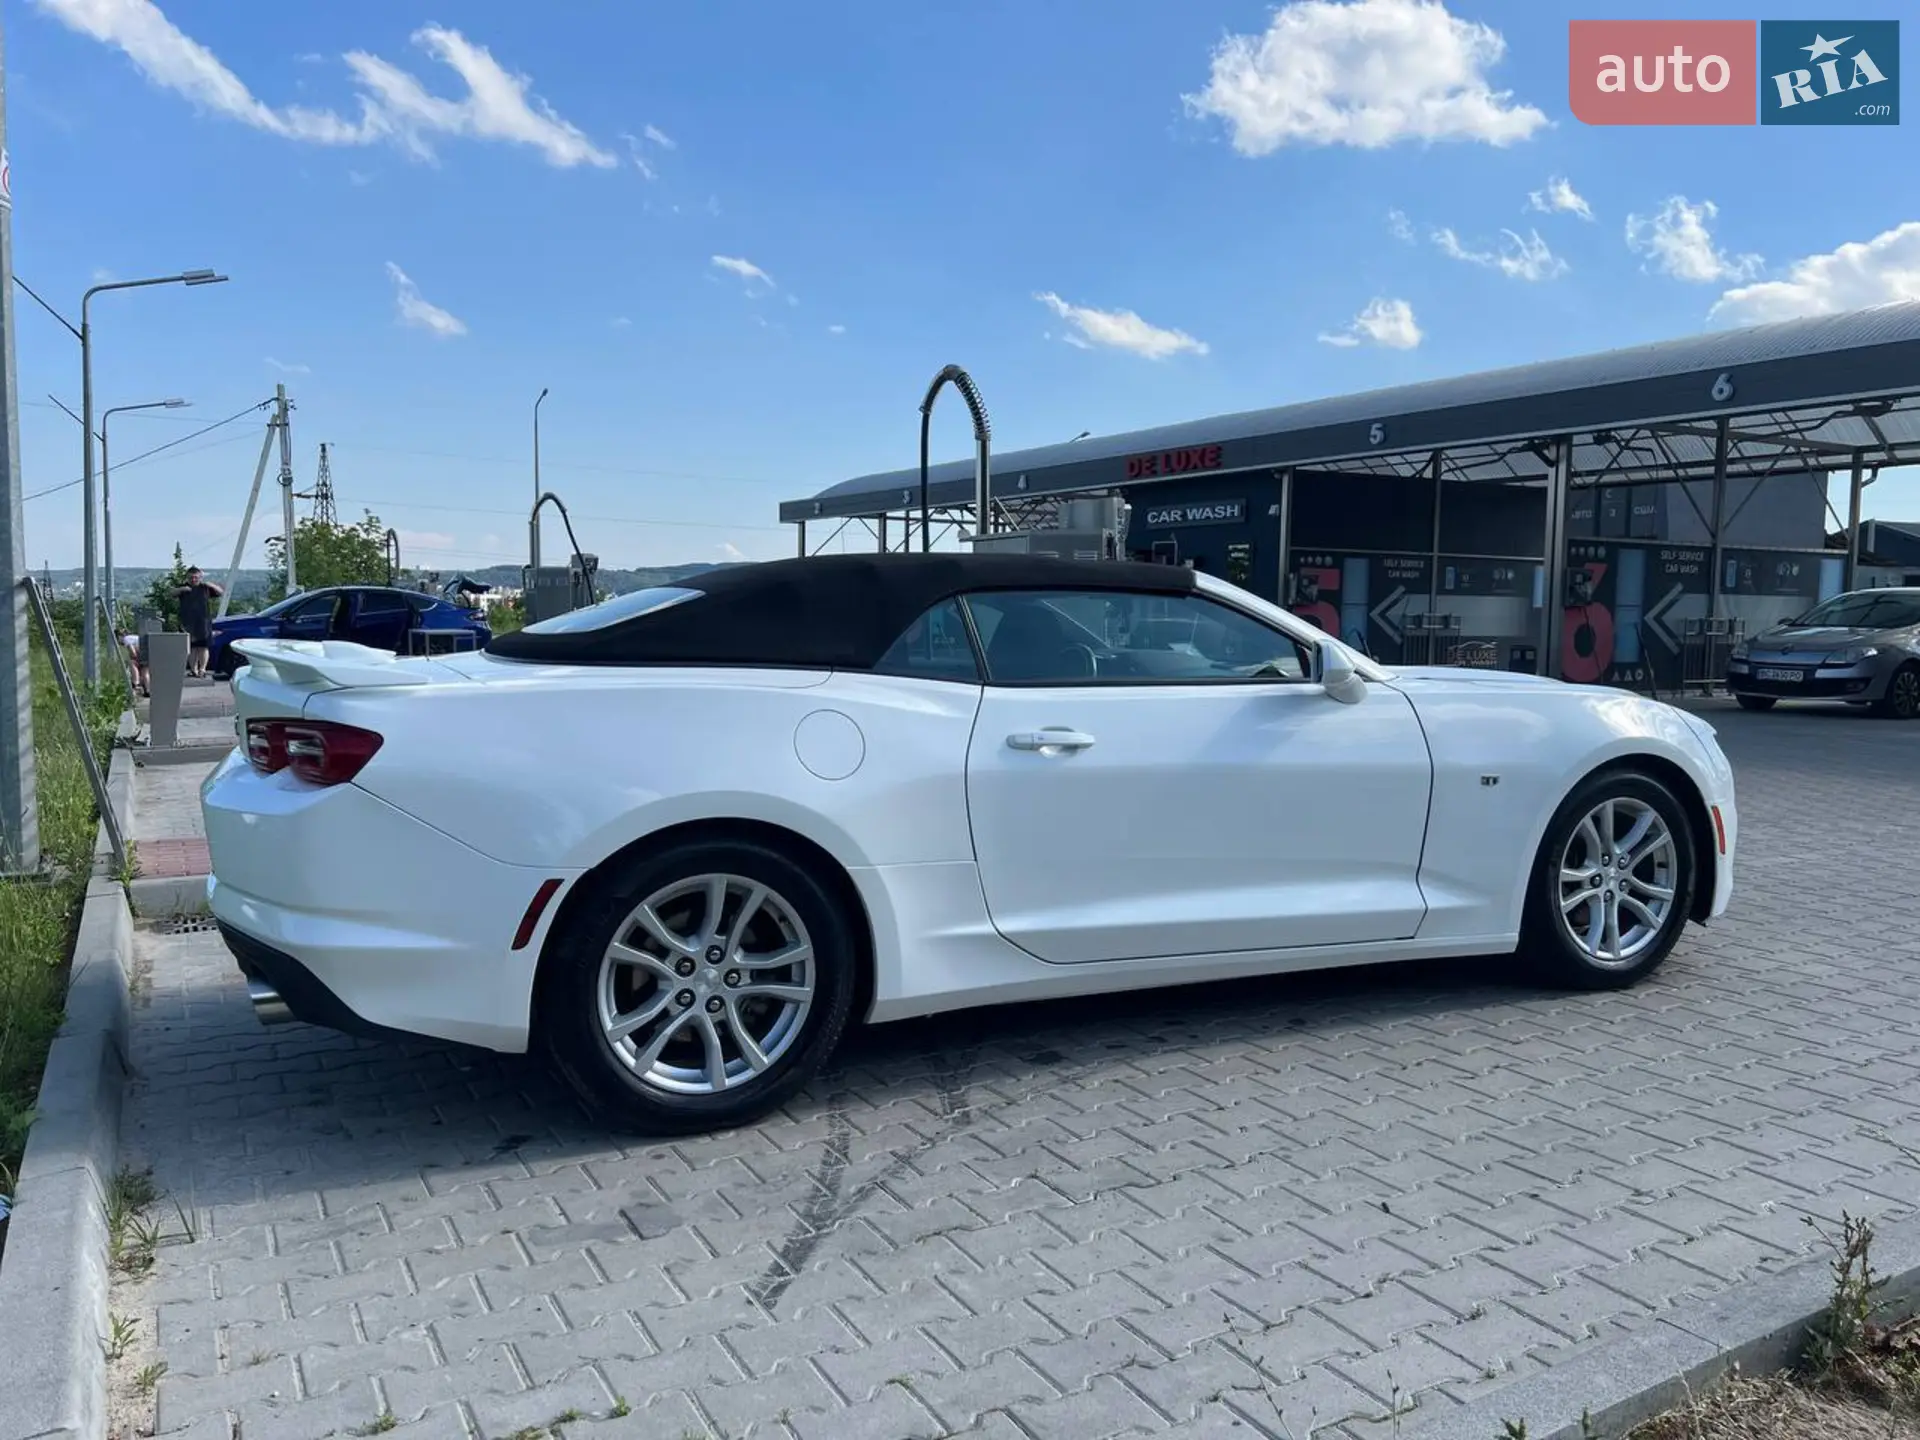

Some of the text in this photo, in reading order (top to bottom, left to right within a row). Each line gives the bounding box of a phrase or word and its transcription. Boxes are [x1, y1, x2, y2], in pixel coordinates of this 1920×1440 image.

[1711, 373, 1734, 401] 6
[1369, 423, 1385, 445] 5
[1127, 445, 1223, 477] DE LUXE
[1147, 504, 1239, 523] CAR WASH
